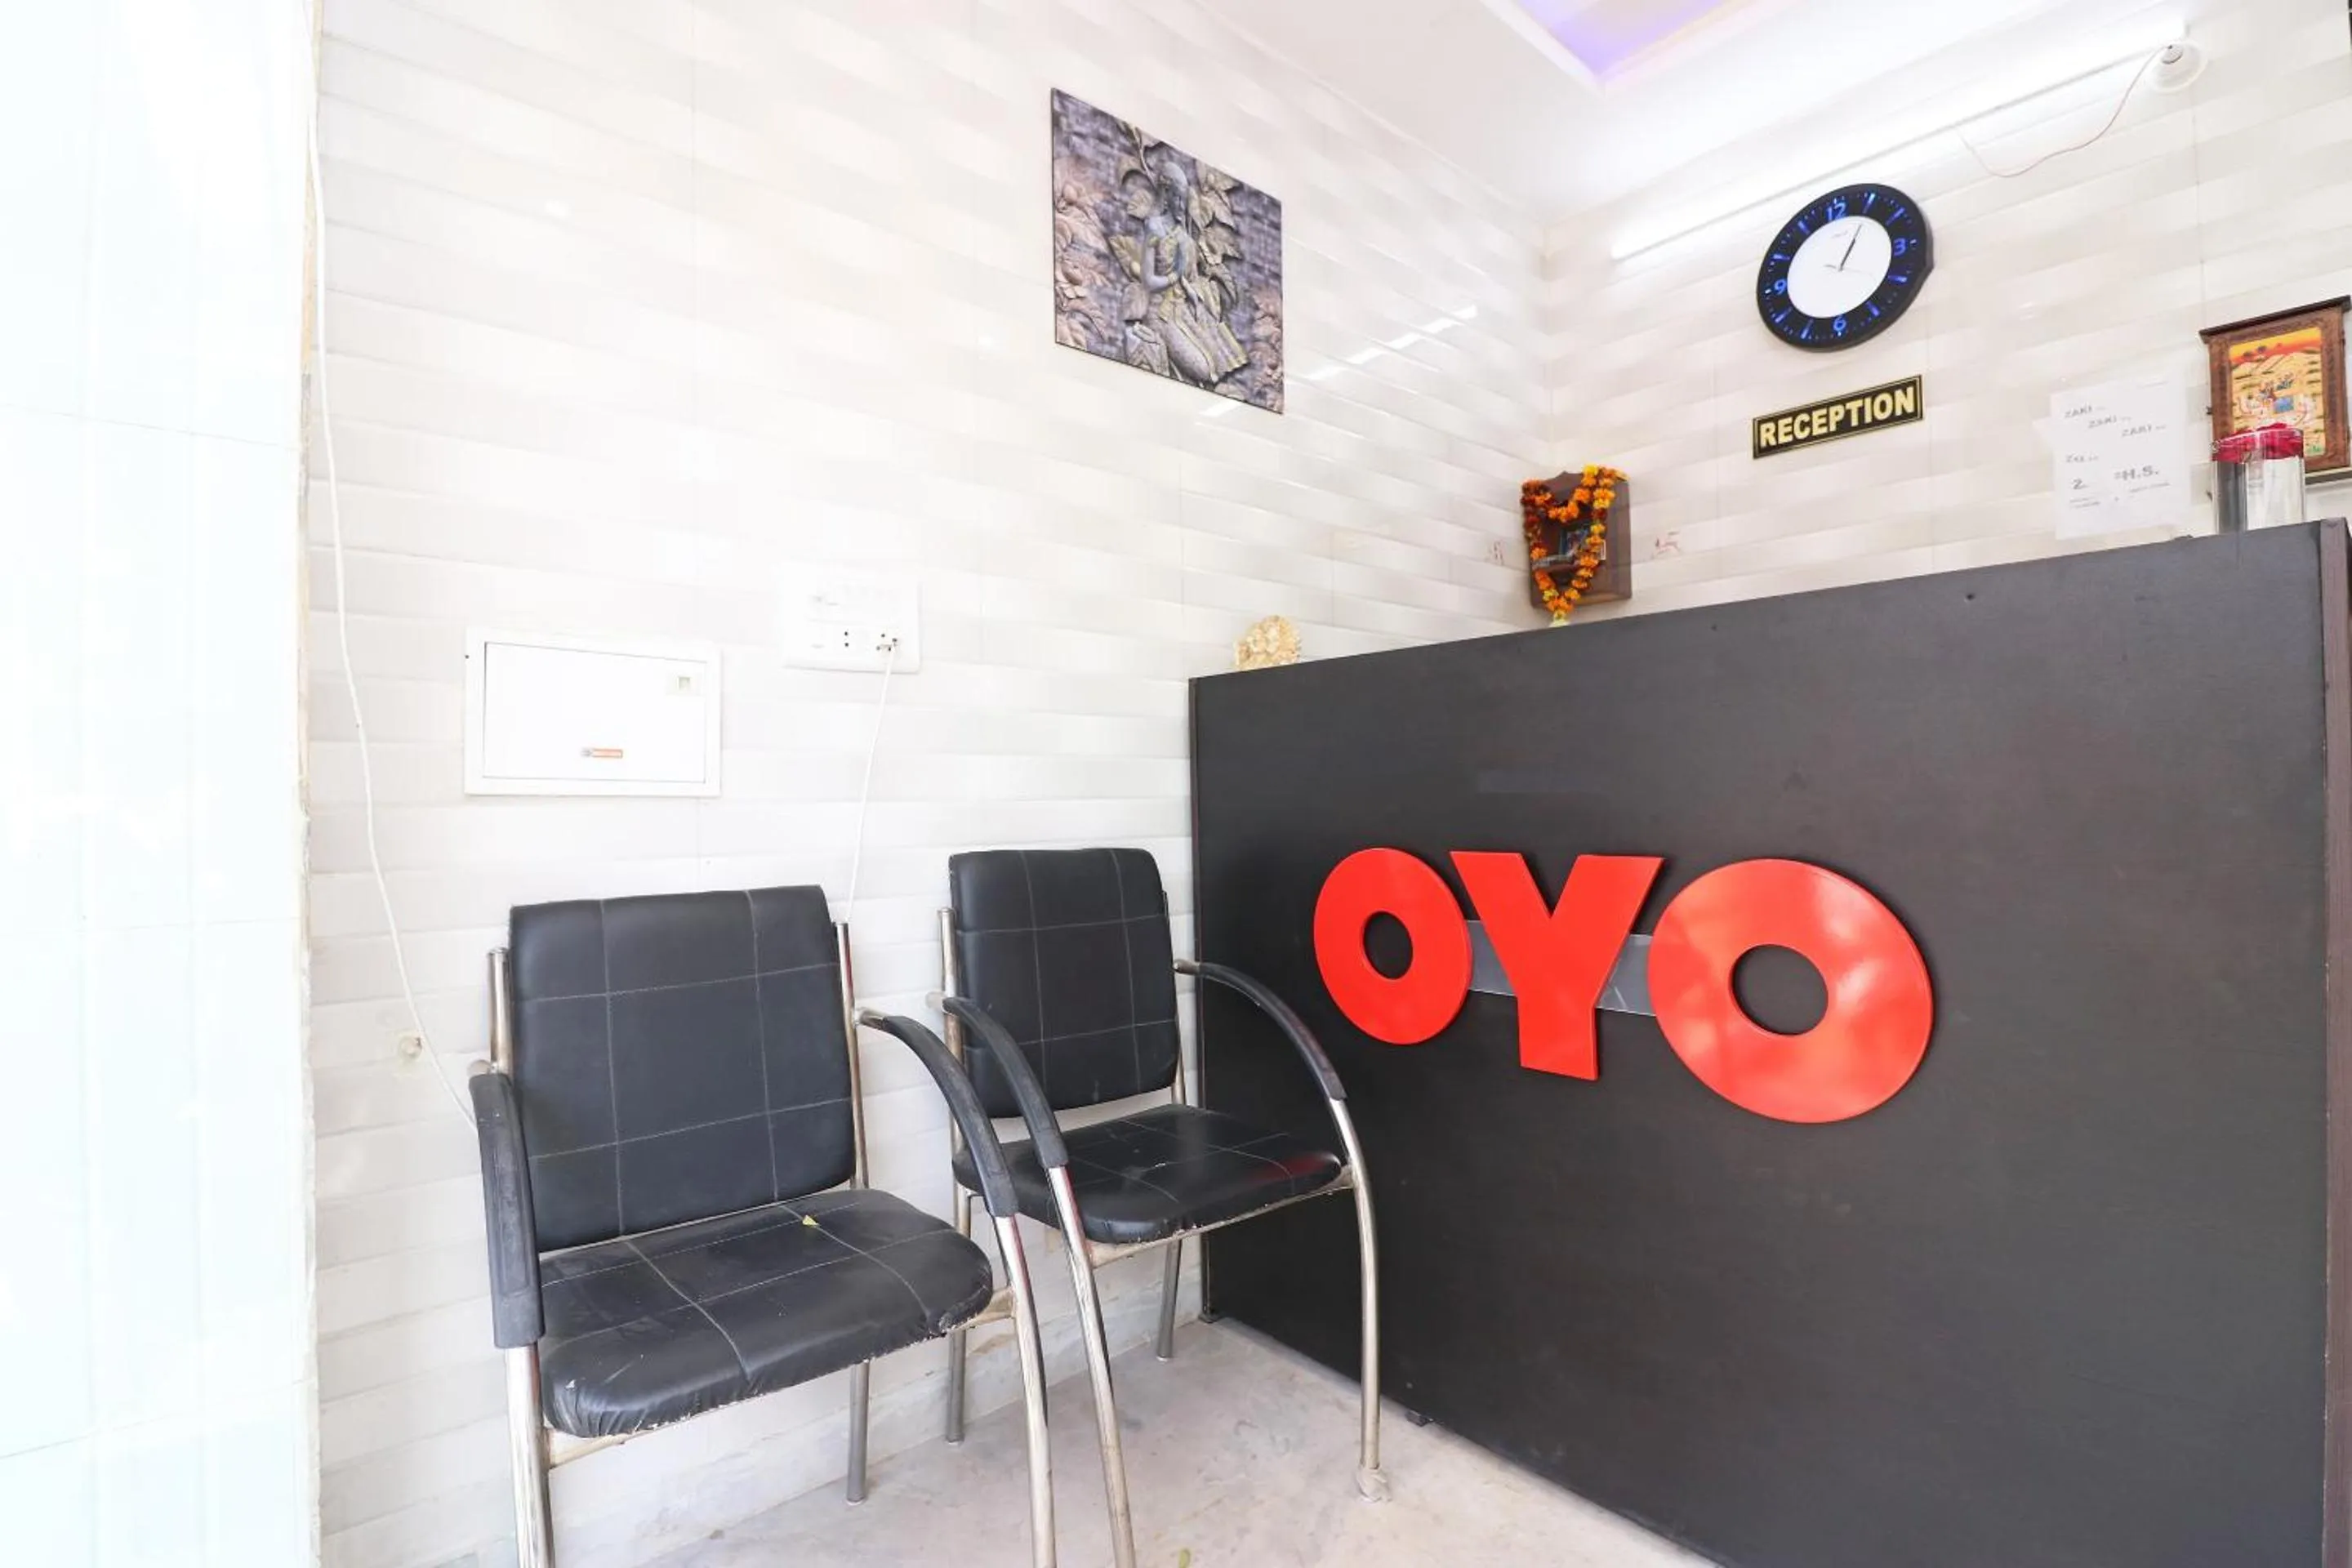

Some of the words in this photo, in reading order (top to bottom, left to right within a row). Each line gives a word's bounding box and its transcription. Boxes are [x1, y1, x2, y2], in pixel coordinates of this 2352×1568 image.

[1825, 202, 1846, 221] 12
[1893, 238, 1906, 256] 3
[1774, 279, 1788, 294] 9
[1833, 314, 1846, 332] 6
[1760, 386, 1915, 448] RECEPTION
[1313, 847, 1933, 1123] OYO
